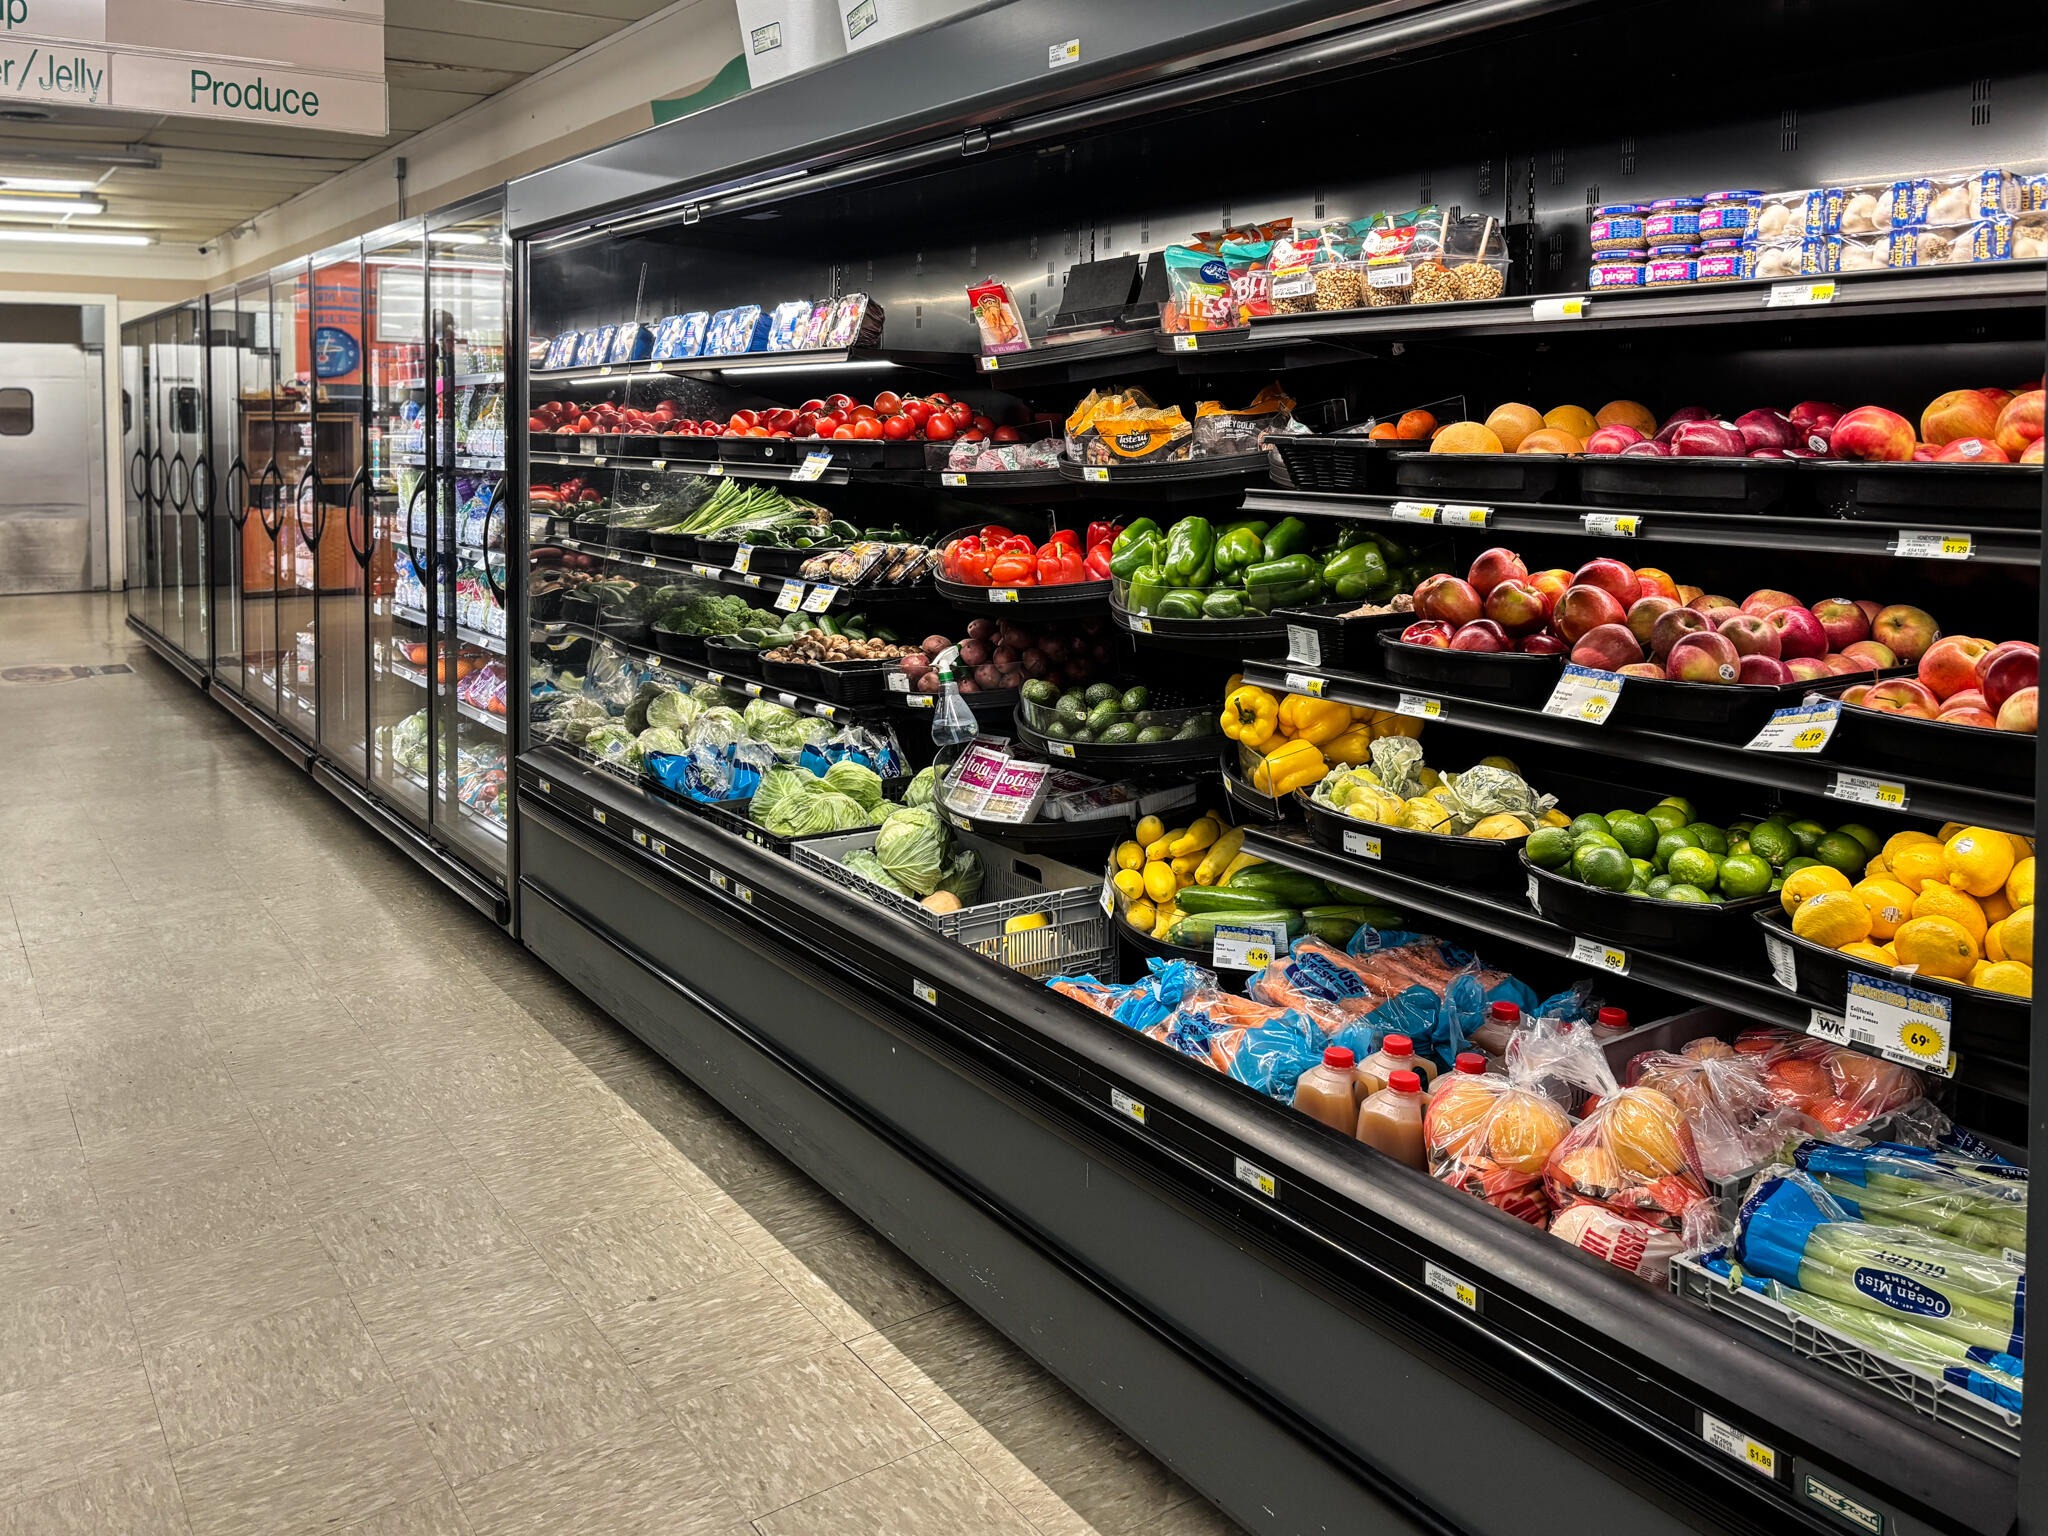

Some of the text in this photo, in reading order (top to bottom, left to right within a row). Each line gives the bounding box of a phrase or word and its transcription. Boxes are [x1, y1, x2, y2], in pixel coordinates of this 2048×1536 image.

[0, 0, 28, 29] p
[0, 59, 15, 85] r
[39, 54, 103, 103] Jelly
[191, 69, 319, 117] Produce
[1655, 265, 1685, 279] ginger
[1701, 261, 1730, 275] ginger
[1604, 270, 1634, 283] ginger
[1945, 545, 1967, 553] $1.29
[1799, 731, 1822, 742] $1.19
[966, 760, 991, 777] tofu
[1000, 771, 1029, 787] tofu
[1875, 791, 1896, 802] $1.19
[1249, 951, 1268, 961] $1.49
[1604, 954, 1621, 967] 49¢
[1850, 982, 1948, 1020] ADVERTISED SPECIAL
[1850, 1005, 1874, 1017] California
[1884, 1274, 1920, 1291] FARMS
[1858, 1273, 1945, 1313] Ocean Mist
[1749, 1448, 1772, 1467] $1.89
[1808, 1485, 1878, 1526] ZERO ZONE
